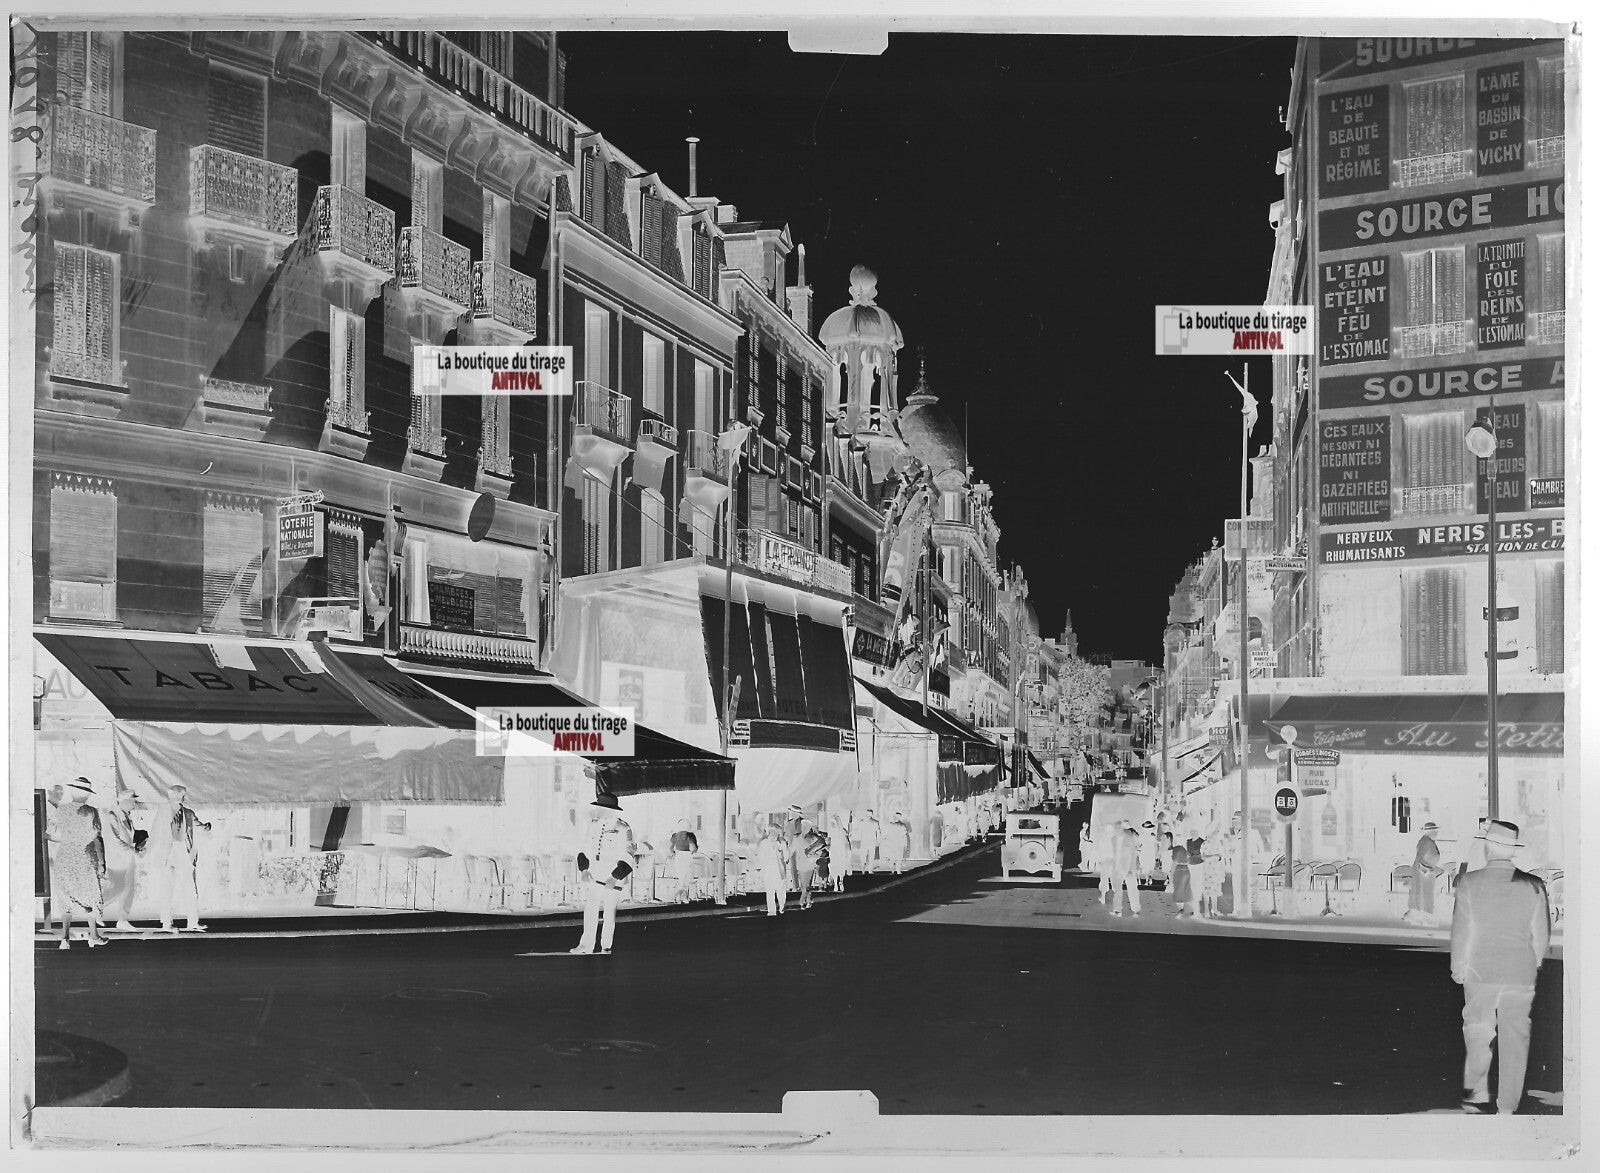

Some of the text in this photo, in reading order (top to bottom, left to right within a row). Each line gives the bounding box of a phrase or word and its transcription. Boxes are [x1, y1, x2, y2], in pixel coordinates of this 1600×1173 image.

[1331, 94, 1374, 113] L'EAU
[1491, 93, 1510, 104] DU
[1343, 113, 1364, 124] DE
[1478, 104, 1521, 127] BASSIN
[1328, 122, 1379, 146] BEAUTÉ
[1489, 129, 1508, 141] DE
[1340, 143, 1370, 159] ET DE
[1478, 142, 1523, 166] VICHY
[1325, 157, 1383, 182] RÉGIME
[1355, 193, 1492, 240] SOURCE
[1478, 246, 1490, 263] LA
[1325, 259, 1385, 282] L'EAU
[1489, 260, 1512, 270] DU
[1338, 278, 1368, 290] QUI
[1485, 269, 1518, 290] FOIE
[1487, 288, 1515, 298] DES
[1343, 305, 1365, 315] LE
[1480, 295, 1524, 317] REINS
[1338, 313, 1370, 333] FEU
[1491, 316, 1510, 325] DE
[1343, 332, 1364, 341] DE
[1478, 322, 1525, 344] L'ESTOMAC
[1323, 337, 1389, 361] L'ESTOMAC
[1363, 365, 1523, 401] SOURCE
[1494, 413, 1520, 429] EAU
[1324, 422, 1385, 438] CES EAUX
[1322, 439, 1380, 452] NE SONT NI
[1321, 450, 1382, 468] DÉCANTÉES
[1343, 470, 1359, 480] NI
[1484, 480, 1519, 499] DEAU
[280, 516, 314, 530] LOTERIE
[1226, 520, 1274, 532] CONISERIE
[280, 528, 314, 541] NATIONALE
[1336, 529, 1394, 545] NERVEUX
[1326, 546, 1406, 562] RHUMATISANTS
[1525, 542, 1539, 551] DE
[95, 665, 319, 693] TABAC
[1475, 723, 1565, 748] Peti
[1304, 779, 1330, 787] LUCAS
